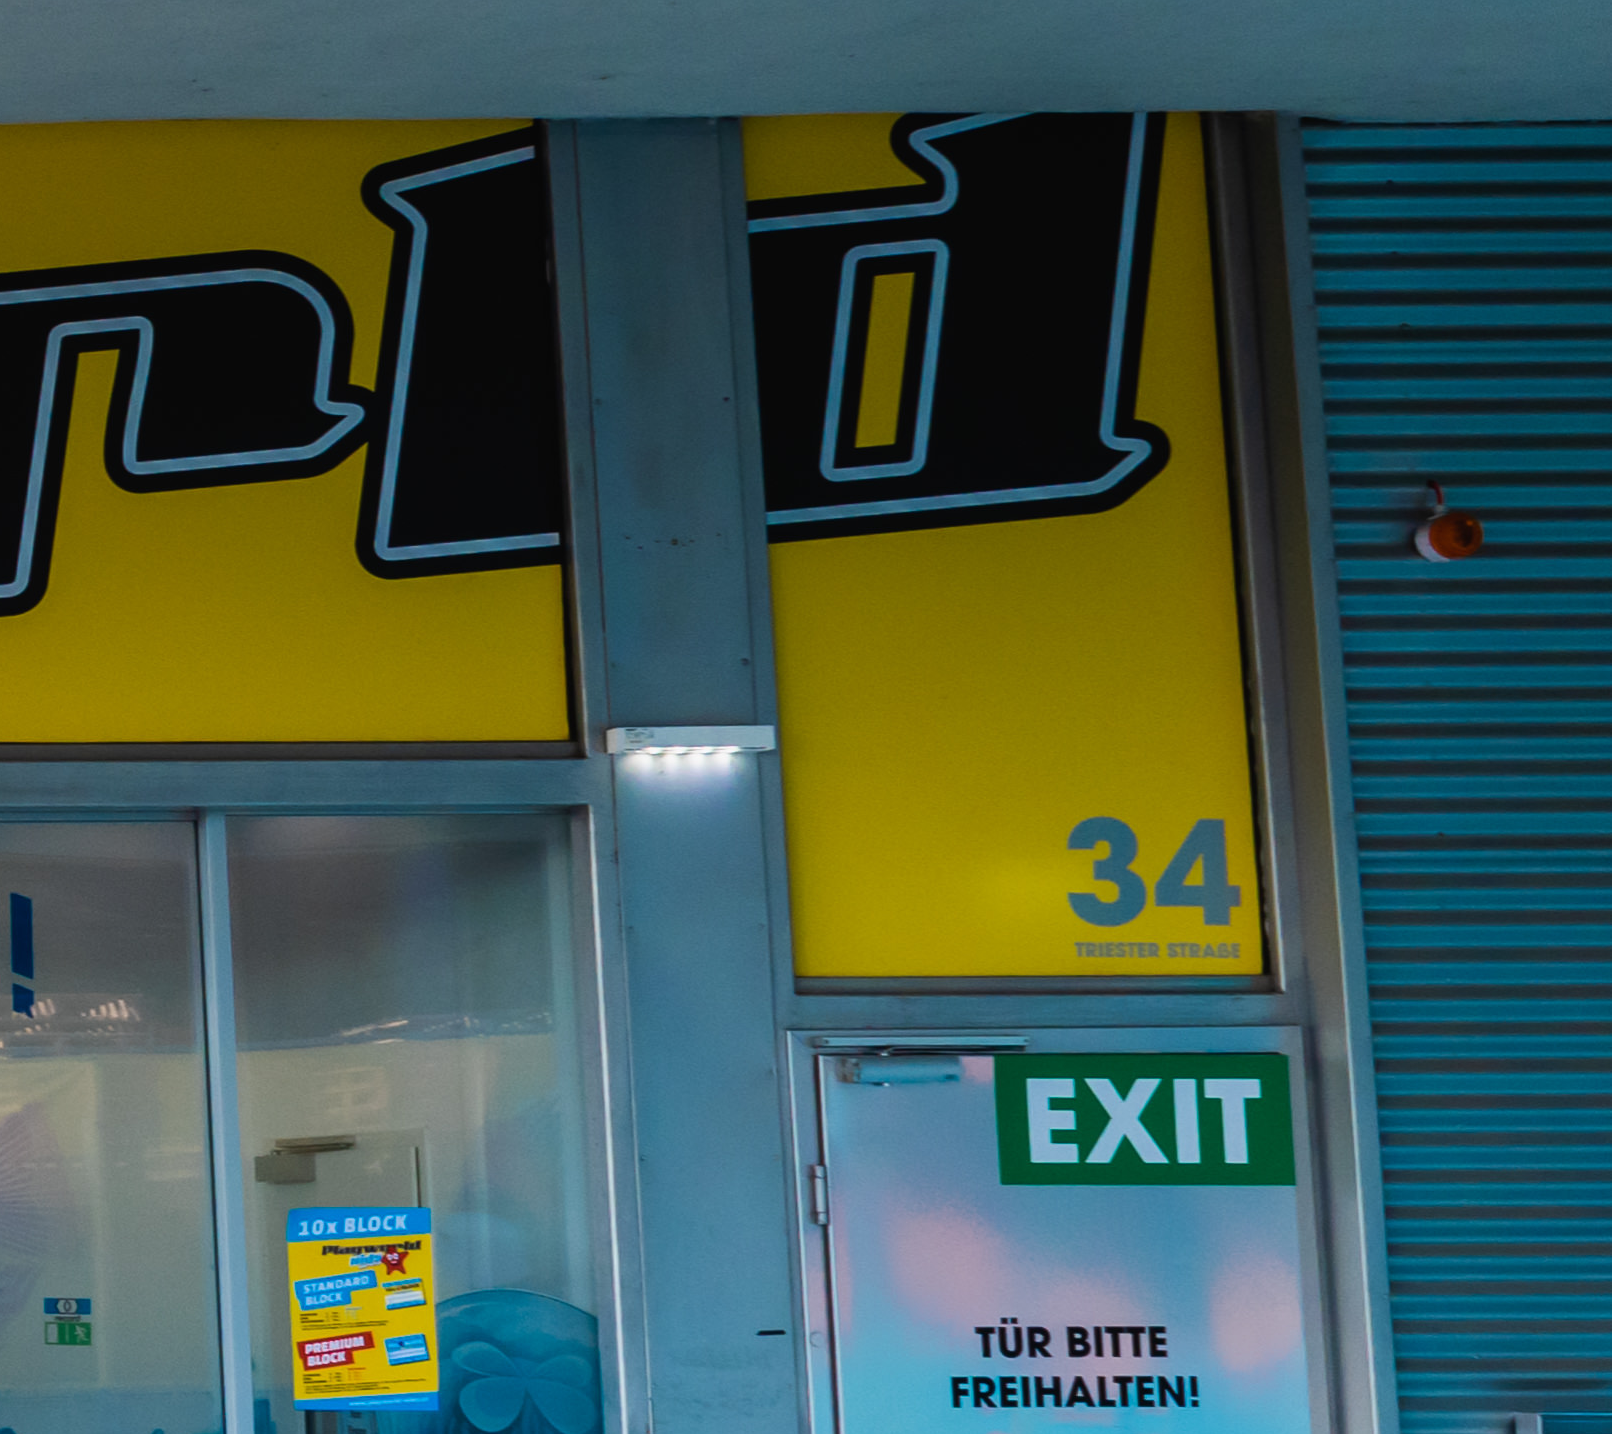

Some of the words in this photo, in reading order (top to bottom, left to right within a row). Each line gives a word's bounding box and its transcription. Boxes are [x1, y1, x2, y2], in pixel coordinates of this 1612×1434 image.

[1067, 815, 1241, 928] 34
[1074, 941, 1160, 958] TRIESTER
[1025, 1077, 1261, 1165] EXIT
[298, 1219, 338, 1236] 10x
[343, 1214, 408, 1234] BLOCK
[303, 1275, 370, 1295] STANDARD
[305, 1292, 343, 1306] BLOCK
[304, 1335, 365, 1355] PREMIUM
[974, 1317, 1053, 1359] TÜR
[1066, 1325, 1168, 1359] BITTE
[307, 1350, 346, 1367] BLOCK
[951, 1375, 1200, 1409] FREIHALTEN!
